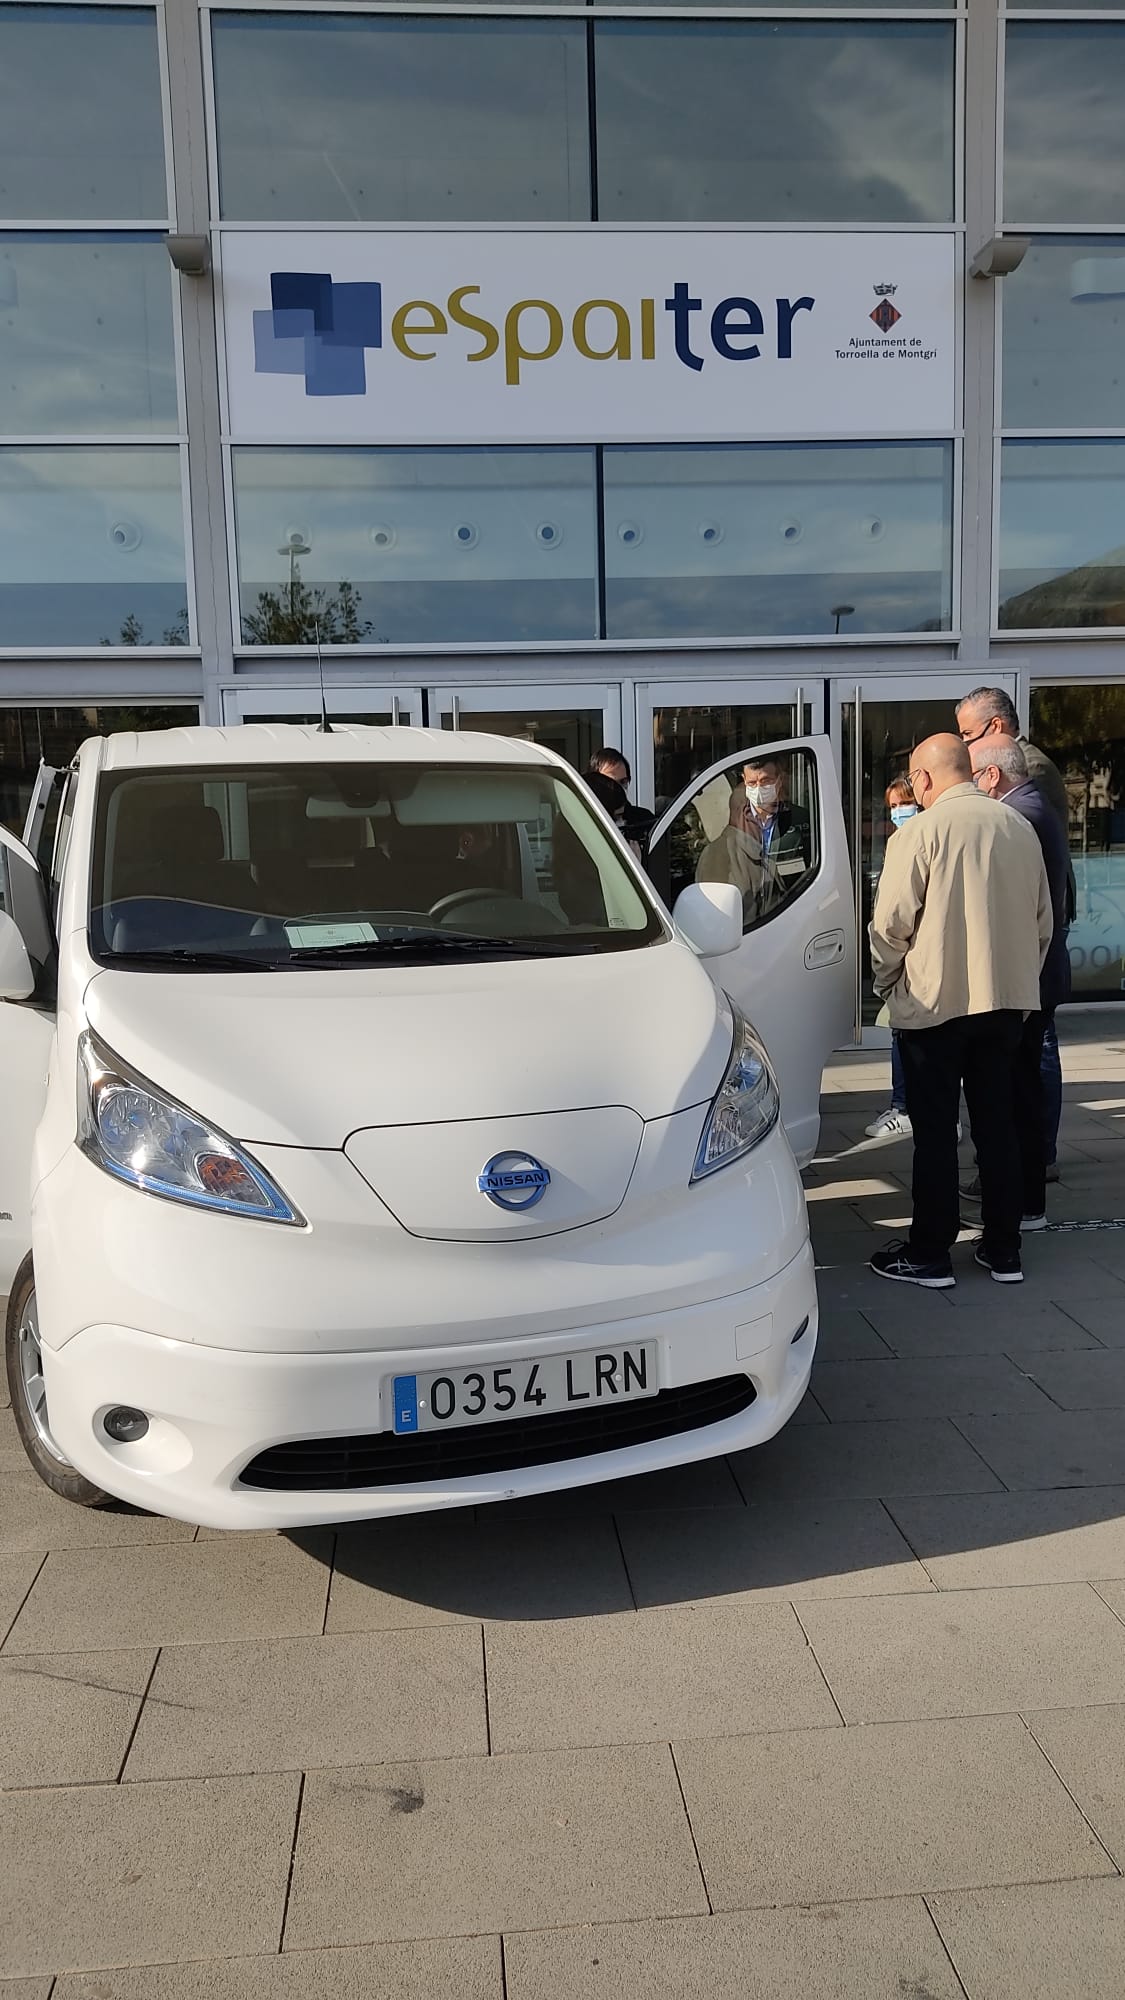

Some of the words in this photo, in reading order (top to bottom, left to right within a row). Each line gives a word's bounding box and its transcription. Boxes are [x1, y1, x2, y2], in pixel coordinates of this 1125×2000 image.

[849, 338, 907, 348] Ajuntament
[909, 338, 922, 346] de
[835, 349, 879, 359] Torroella
[882, 350, 895, 358] de
[487, 1173, 545, 1187] NISSAN
[430, 1364, 547, 1420] 0354
[566, 1348, 648, 1402] LRN
[401, 1410, 412, 1423] E
